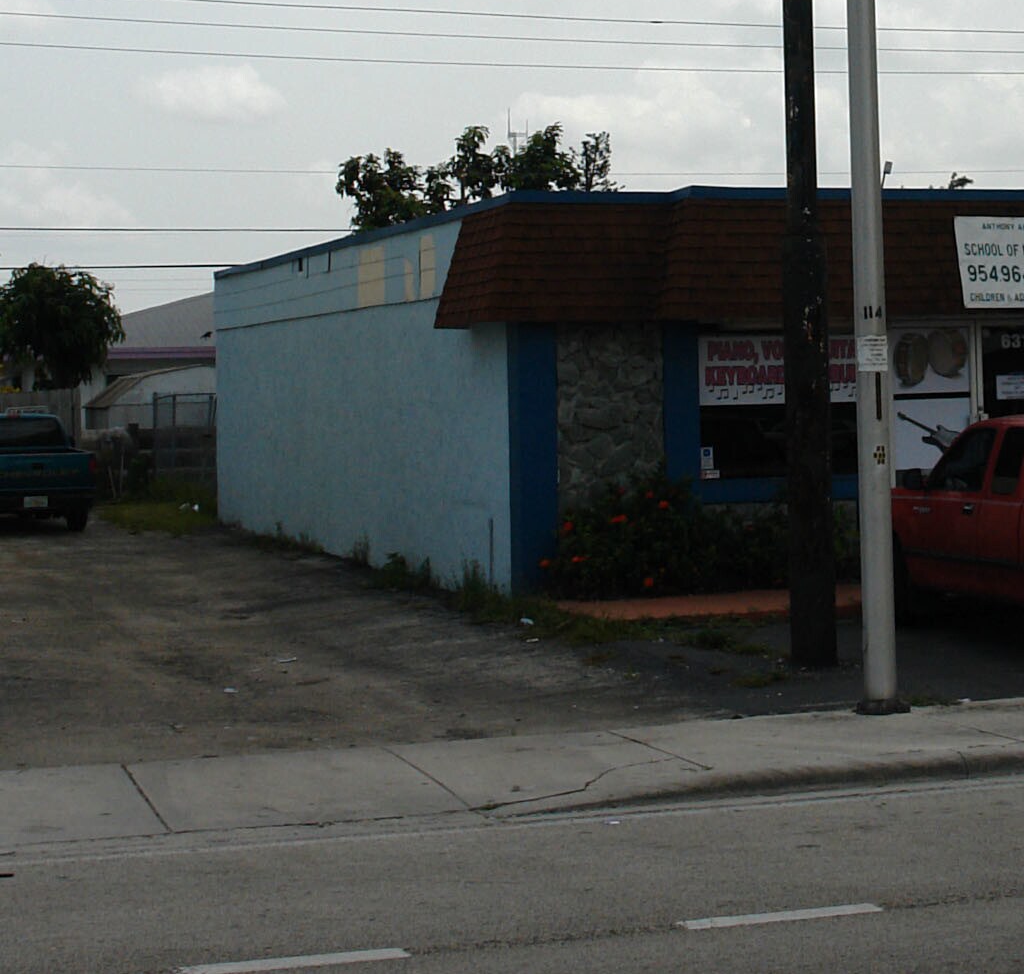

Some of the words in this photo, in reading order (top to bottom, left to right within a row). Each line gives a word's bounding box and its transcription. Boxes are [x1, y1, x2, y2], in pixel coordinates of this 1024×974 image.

[982, 222, 1014, 231] ANTHONY
[964, 242, 1003, 256] SCHOOL
[1006, 244, 1019, 257] OF
[970, 292, 1005, 302] CHILDREN
[708, 340, 759, 364] PIANO,
